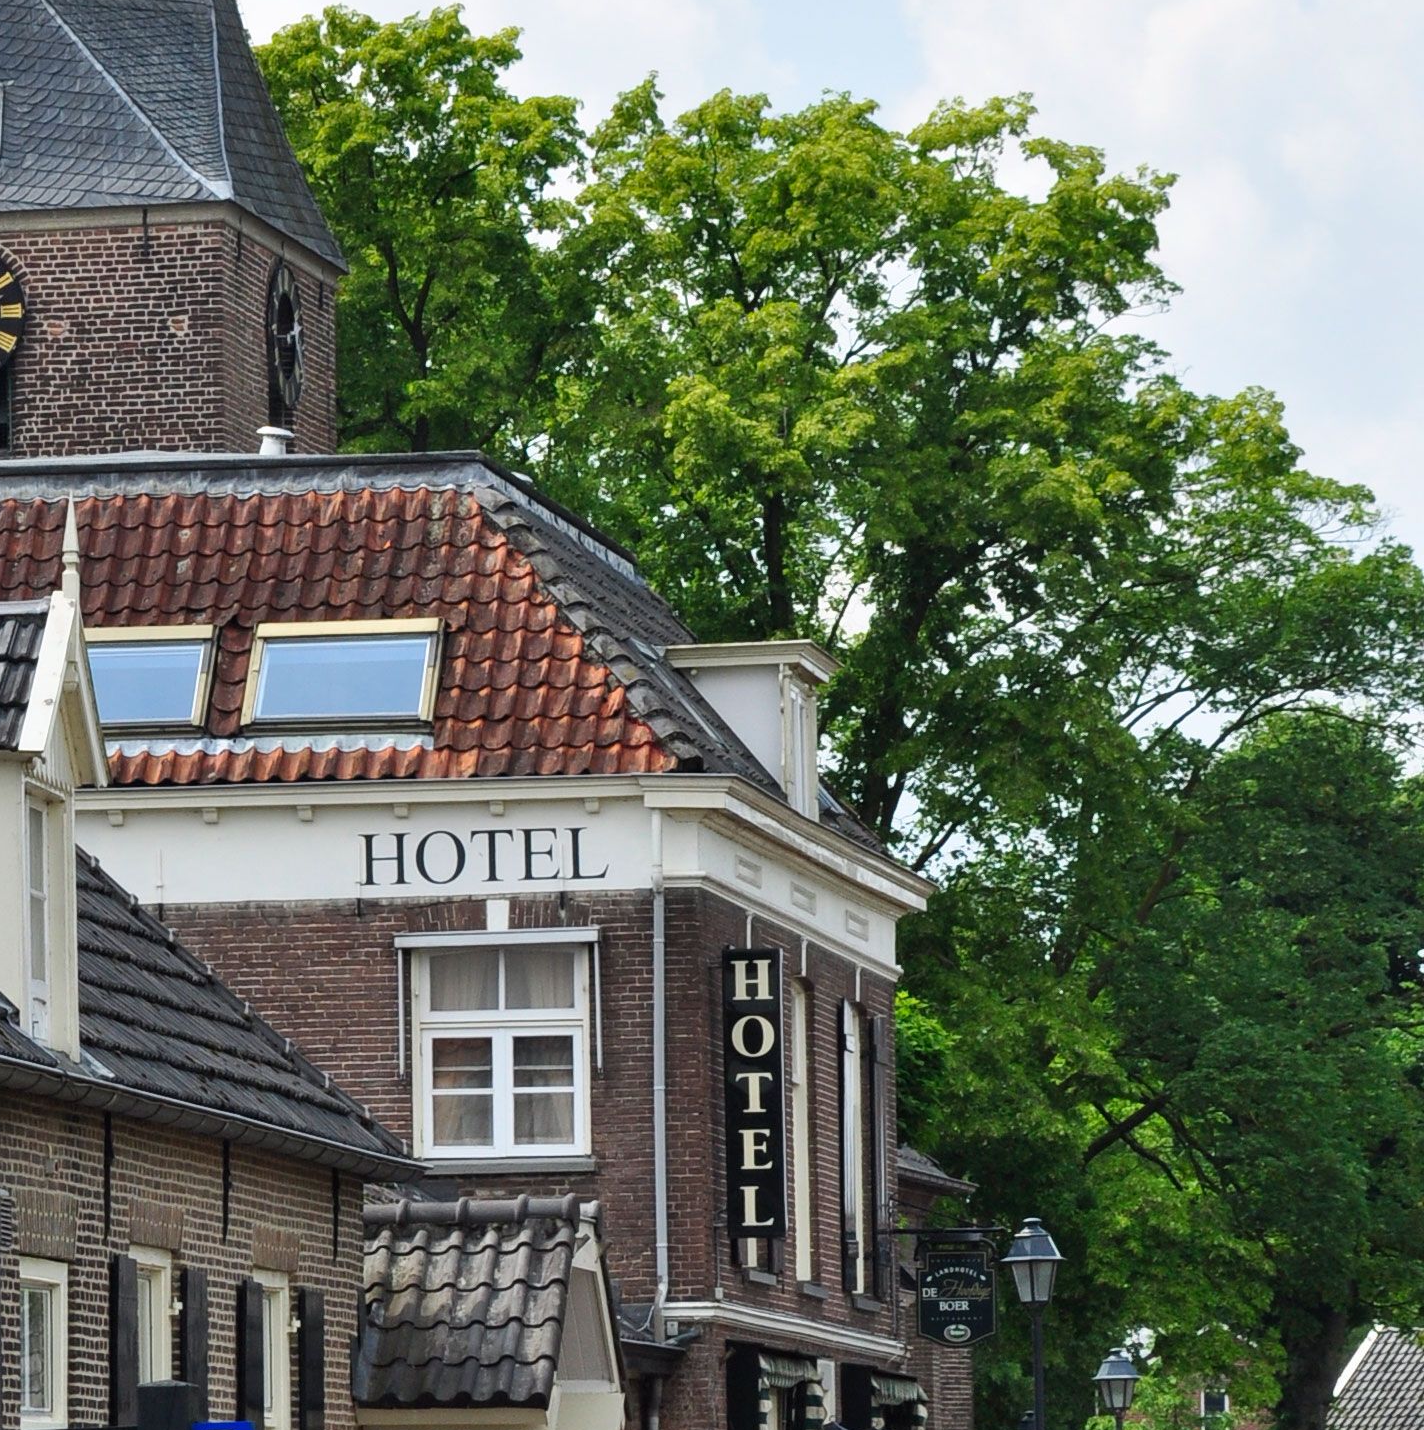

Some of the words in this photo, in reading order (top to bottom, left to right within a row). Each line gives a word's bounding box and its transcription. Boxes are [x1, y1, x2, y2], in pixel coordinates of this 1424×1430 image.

[0, 303, 22, 318] III
[358, 827, 609, 886] HOTEL
[730, 959, 775, 1227] HOTEL
[934, 1266, 977, 1278] LANDHOTEL
[922, 1288, 938, 1298] DE
[939, 1301, 970, 1311] BOER
